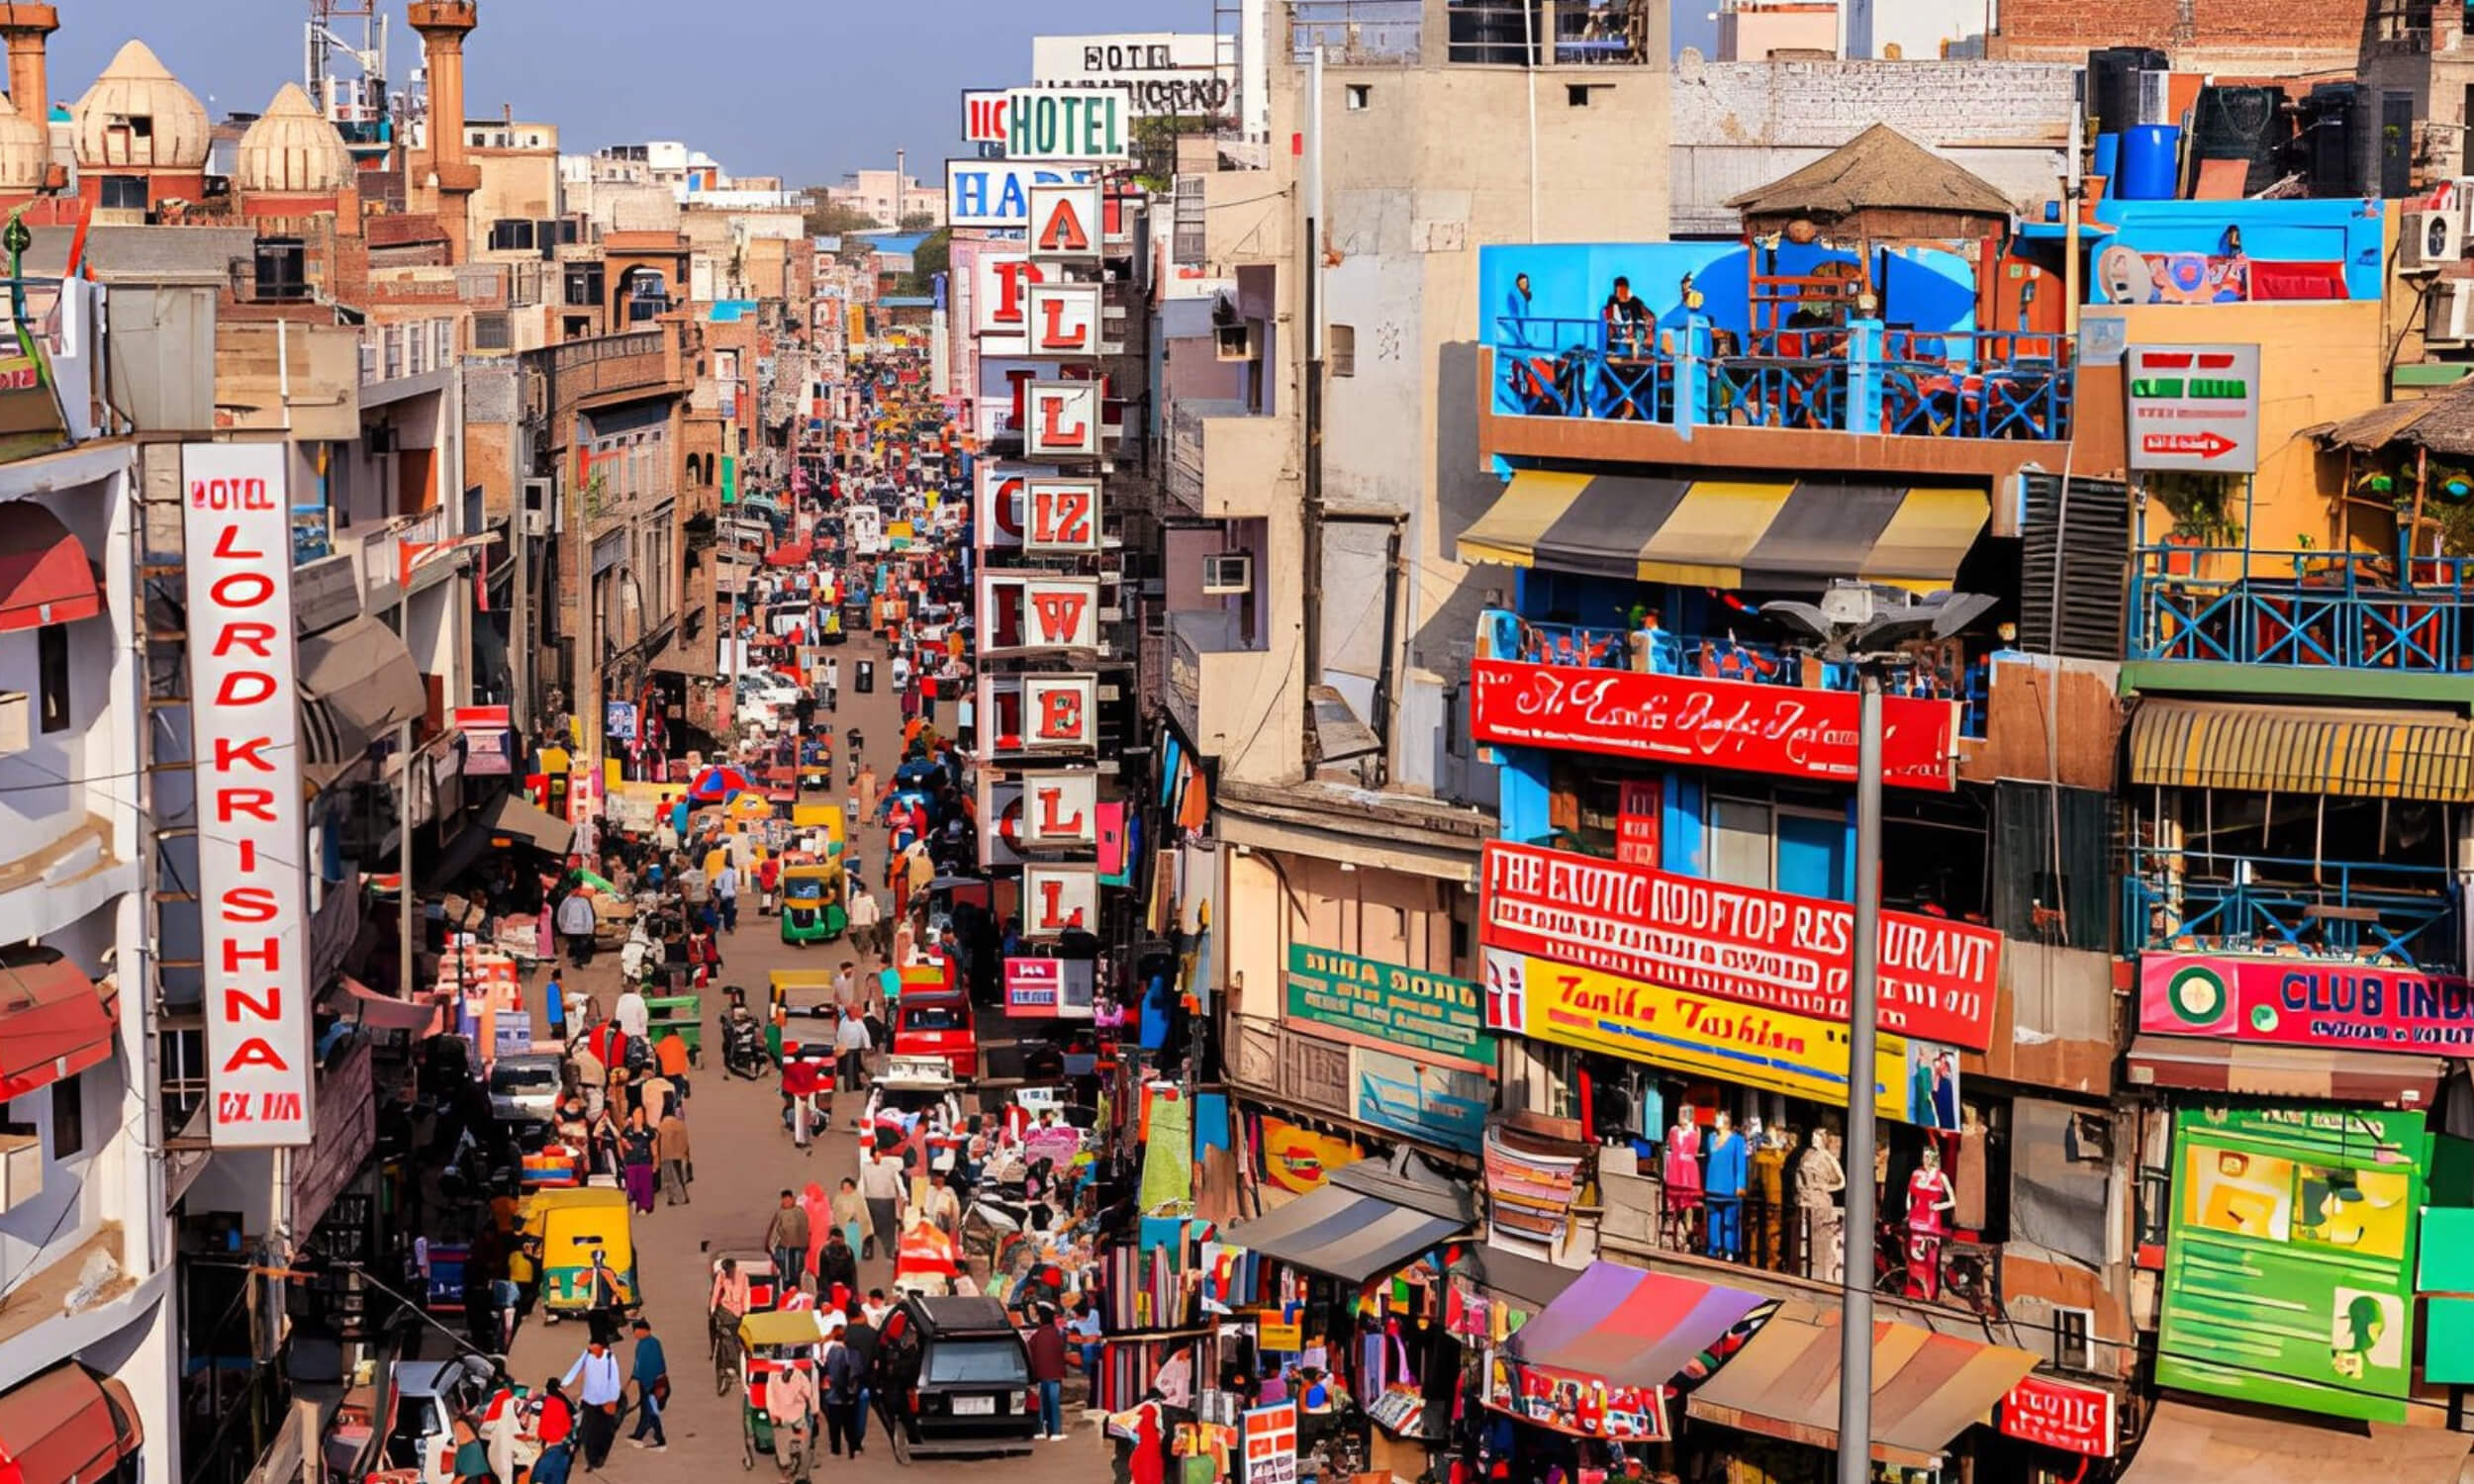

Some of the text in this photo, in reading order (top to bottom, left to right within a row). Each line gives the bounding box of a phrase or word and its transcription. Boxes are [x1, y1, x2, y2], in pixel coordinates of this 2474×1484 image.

[1010, 95, 1122, 155] HOTEL
[210, 524, 288, 1072] LORD KRISHNA
[1491, 849, 1544, 895] THE
[2281, 972, 2383, 1017] CLUB
